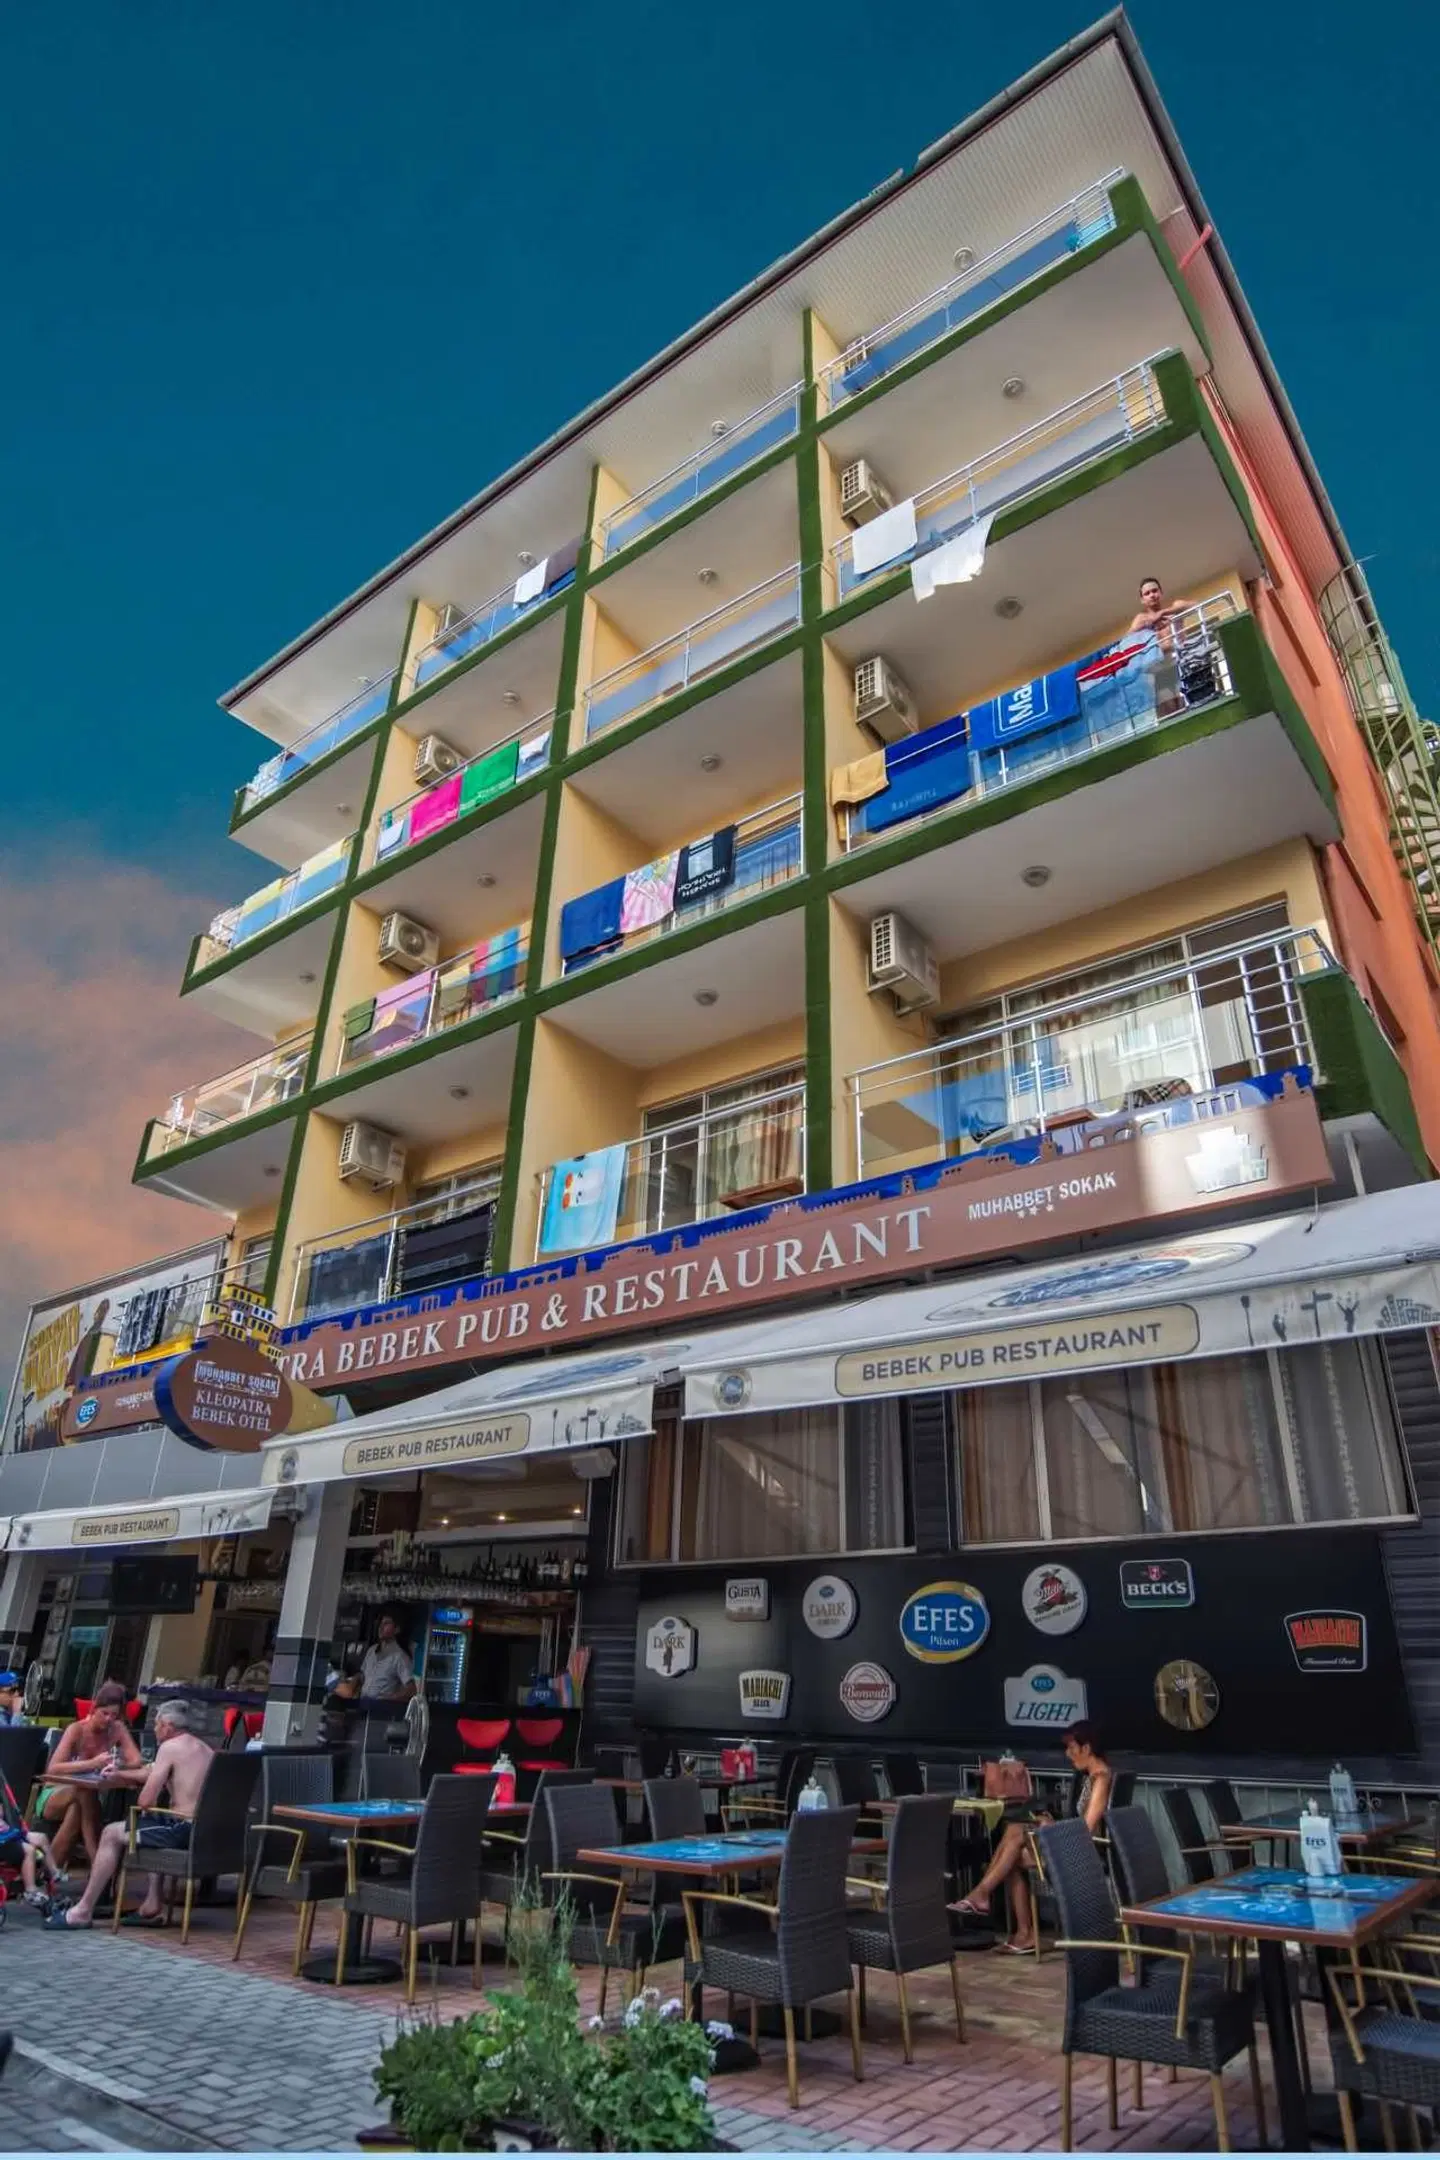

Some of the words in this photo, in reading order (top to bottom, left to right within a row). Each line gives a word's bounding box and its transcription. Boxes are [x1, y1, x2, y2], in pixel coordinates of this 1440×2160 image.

[1007, 683, 1034, 725] Ma
[968, 1185, 1054, 1220] MUHABBET
[1059, 1171, 1118, 1200] SOKAK
[336, 1319, 449, 1374] BEBEK
[455, 1302, 530, 1350] PUB
[541, 1292, 568, 1331] &
[580, 1206, 932, 1322] RESTAURANT
[862, 1354, 932, 1382] BEBEK
[939, 1346, 985, 1370] PUB
[992, 1321, 1164, 1364] RESTAURANT
[196, 1389, 272, 1416] KLEOPATRA
[191, 1406, 236, 1427] BEBEK
[238, 1412, 272, 1432] OTEL
[356, 1443, 396, 1464] BEBEK
[398, 1440, 422, 1458] PUB
[425, 1426, 513, 1456] RESTAURANT
[80, 1525, 102, 1537] BEBEK
[103, 1523, 118, 1535] PUB
[119, 1517, 170, 1534] RESTAURANT
[1127, 1580, 1187, 1596] BECK'S
[808, 1602, 847, 1619] DARK
[913, 1605, 975, 1633] EFES
[930, 1634, 959, 1647] Pilsen
[1013, 1702, 1078, 1722] LIGHT
